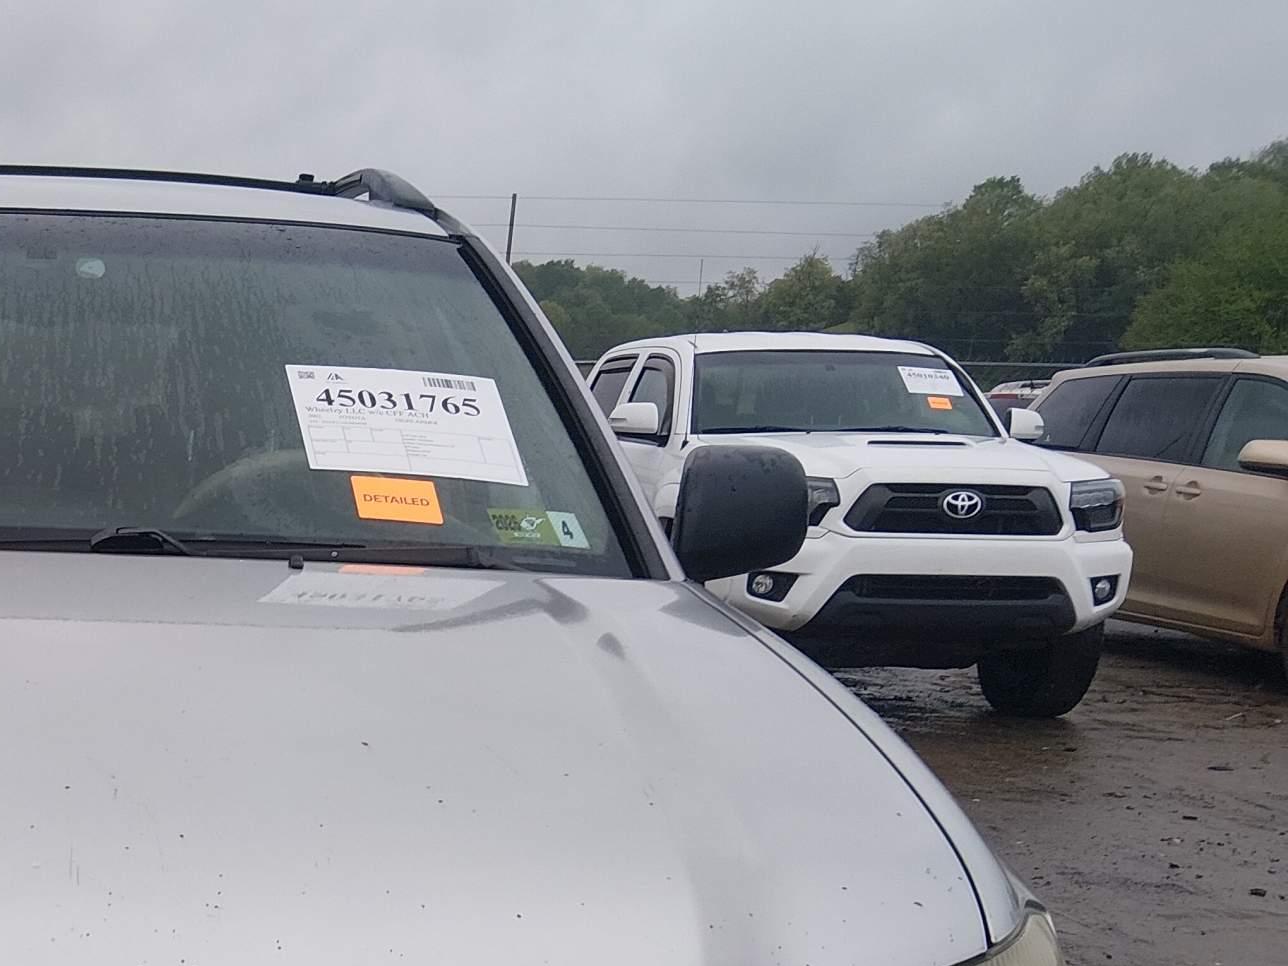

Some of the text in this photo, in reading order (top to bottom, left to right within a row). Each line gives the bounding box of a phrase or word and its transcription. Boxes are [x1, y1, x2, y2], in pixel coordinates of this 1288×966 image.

[316, 388, 481, 417] 45031765
[362, 493, 430, 507] DETAILED
[561, 520, 574, 540] 4
